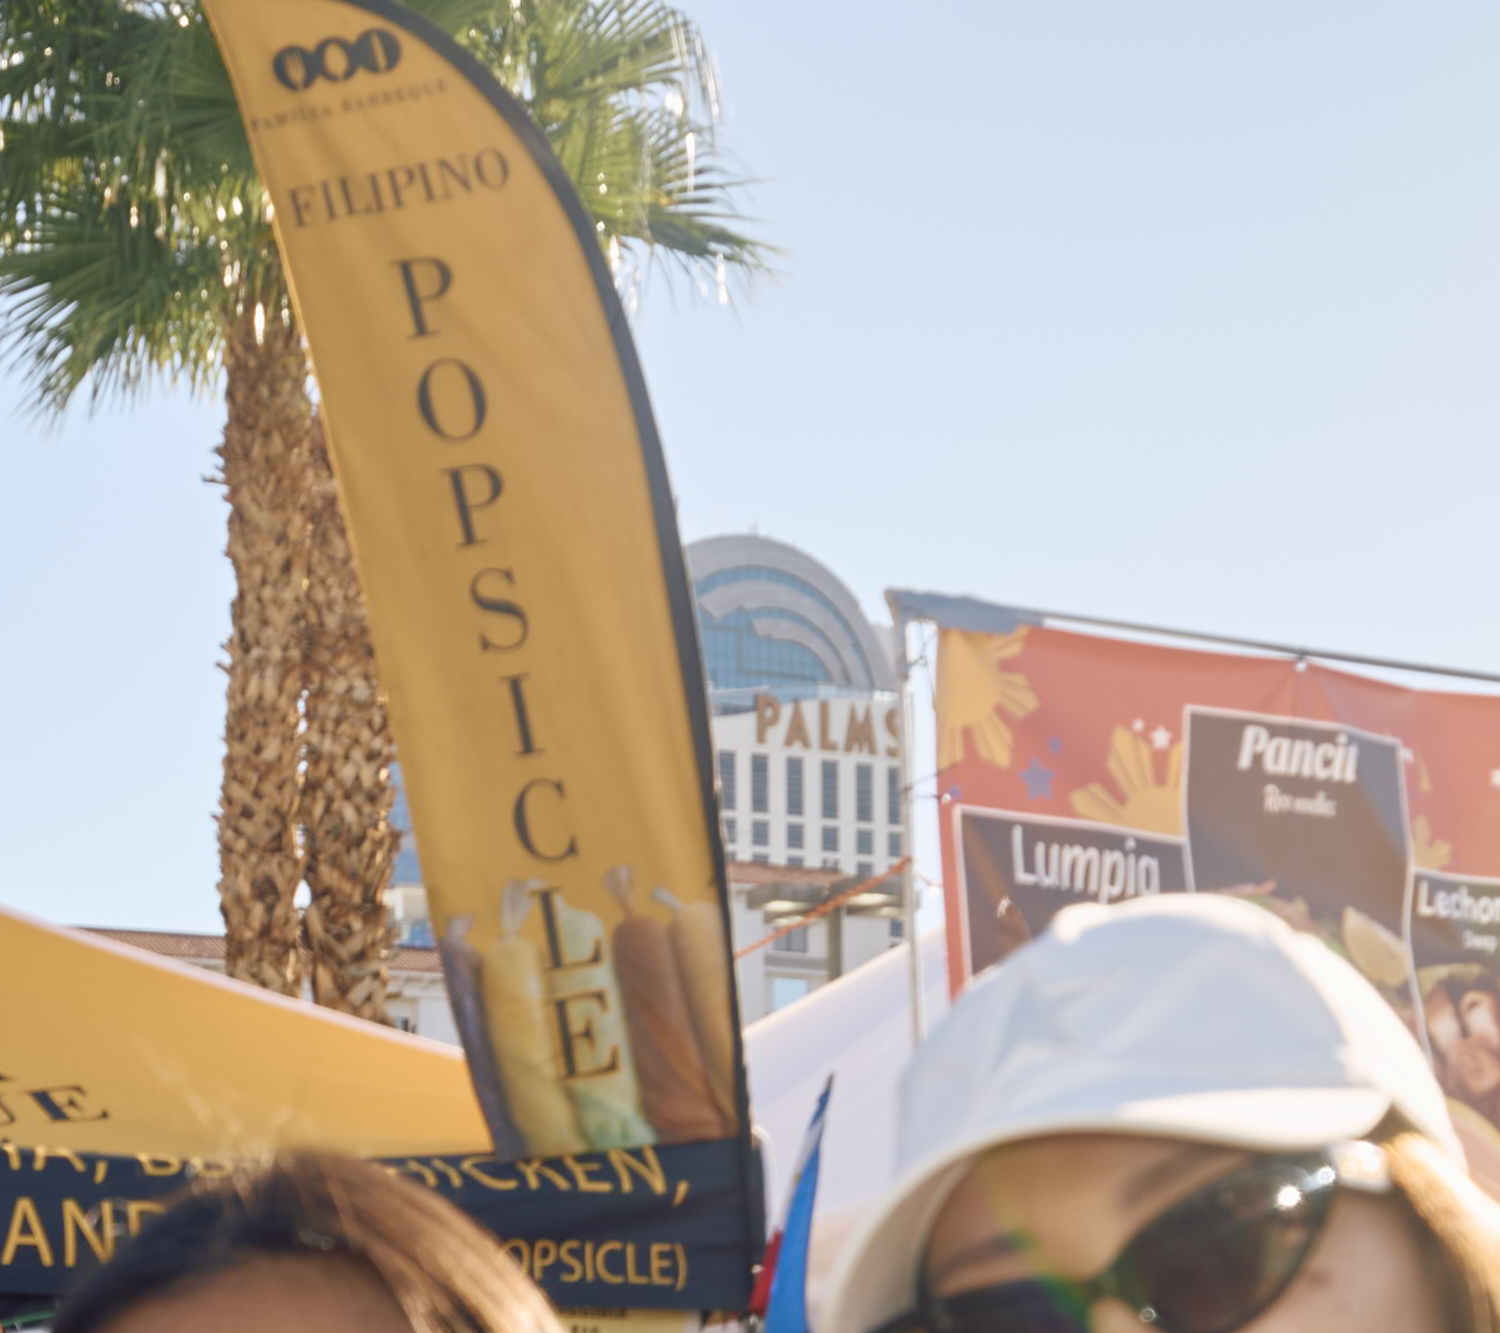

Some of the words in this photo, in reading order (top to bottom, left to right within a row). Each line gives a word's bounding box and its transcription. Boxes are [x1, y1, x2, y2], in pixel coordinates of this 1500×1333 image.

[288, 147, 512, 228] FILIPINO
[391, 255, 618, 1082] POPSICLE
[754, 691, 899, 757] PALMS
[1238, 724, 1358, 782] Pancit
[1012, 824, 1160, 904] Lumpia
